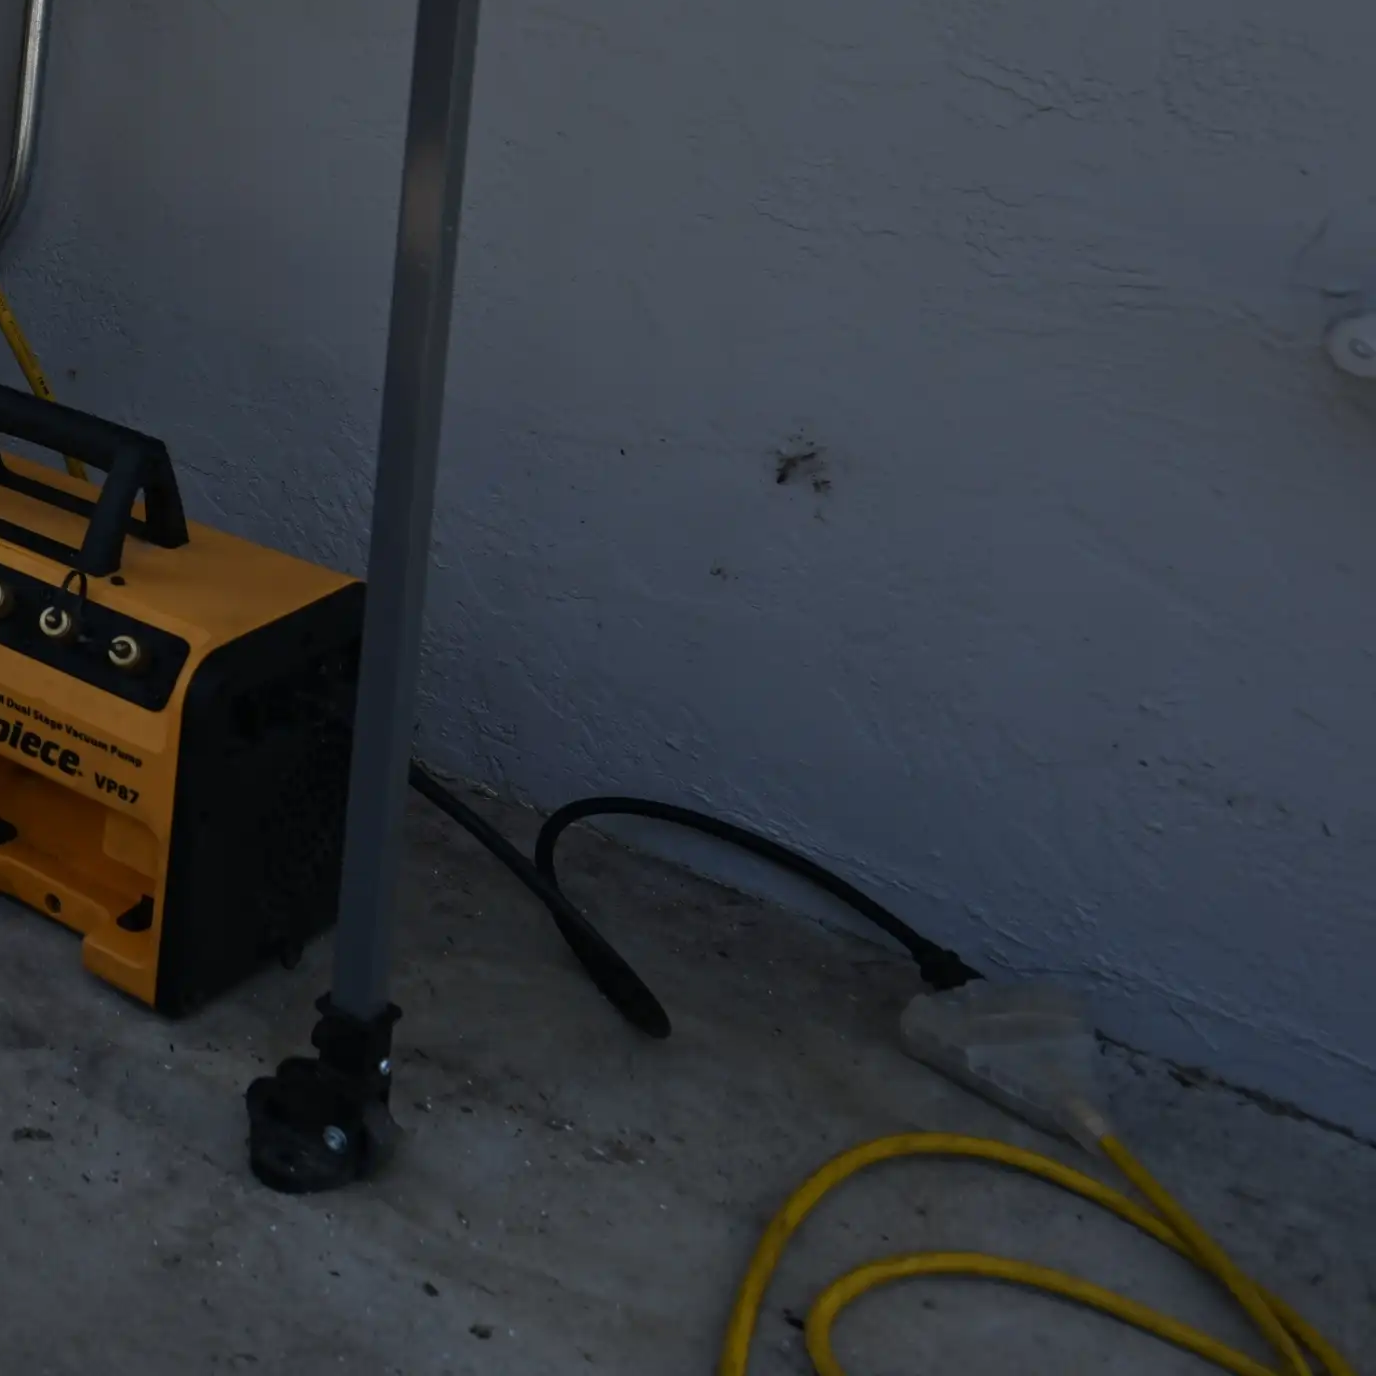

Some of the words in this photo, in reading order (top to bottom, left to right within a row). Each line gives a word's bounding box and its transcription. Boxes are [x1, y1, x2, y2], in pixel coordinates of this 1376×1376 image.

[6, 697, 31, 717] Dual
[33, 707, 63, 732] Stage
[64, 720, 108, 752] Vacuum
[110, 743, 143, 768] Pump
[94, 772, 140, 805] VP87
